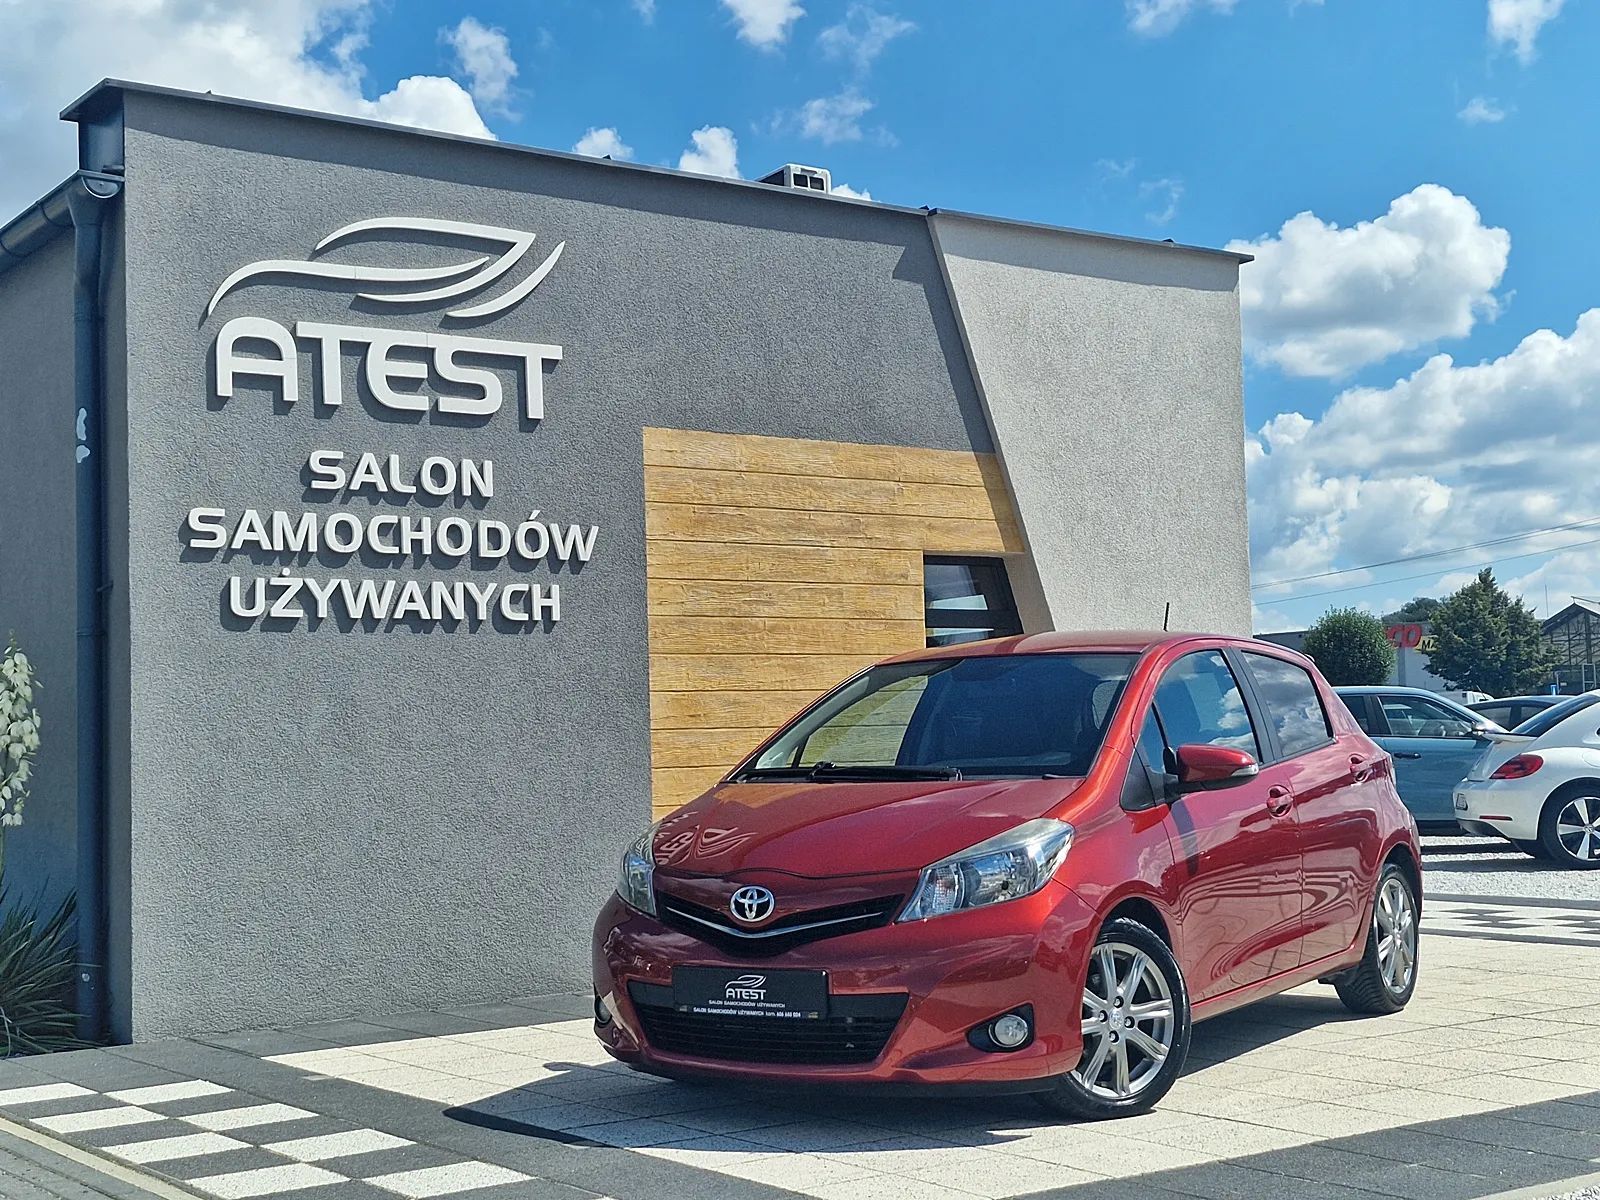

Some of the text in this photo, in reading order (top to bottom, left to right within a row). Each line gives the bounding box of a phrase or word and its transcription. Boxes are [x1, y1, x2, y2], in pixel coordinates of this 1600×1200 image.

[217, 316, 563, 419] ATEST
[309, 450, 494, 498] SALON
[187, 507, 599, 562] SAMOCHODÓW
[229, 567, 561, 622] UŻYWANYCH
[726, 988, 767, 1000] ATEST
